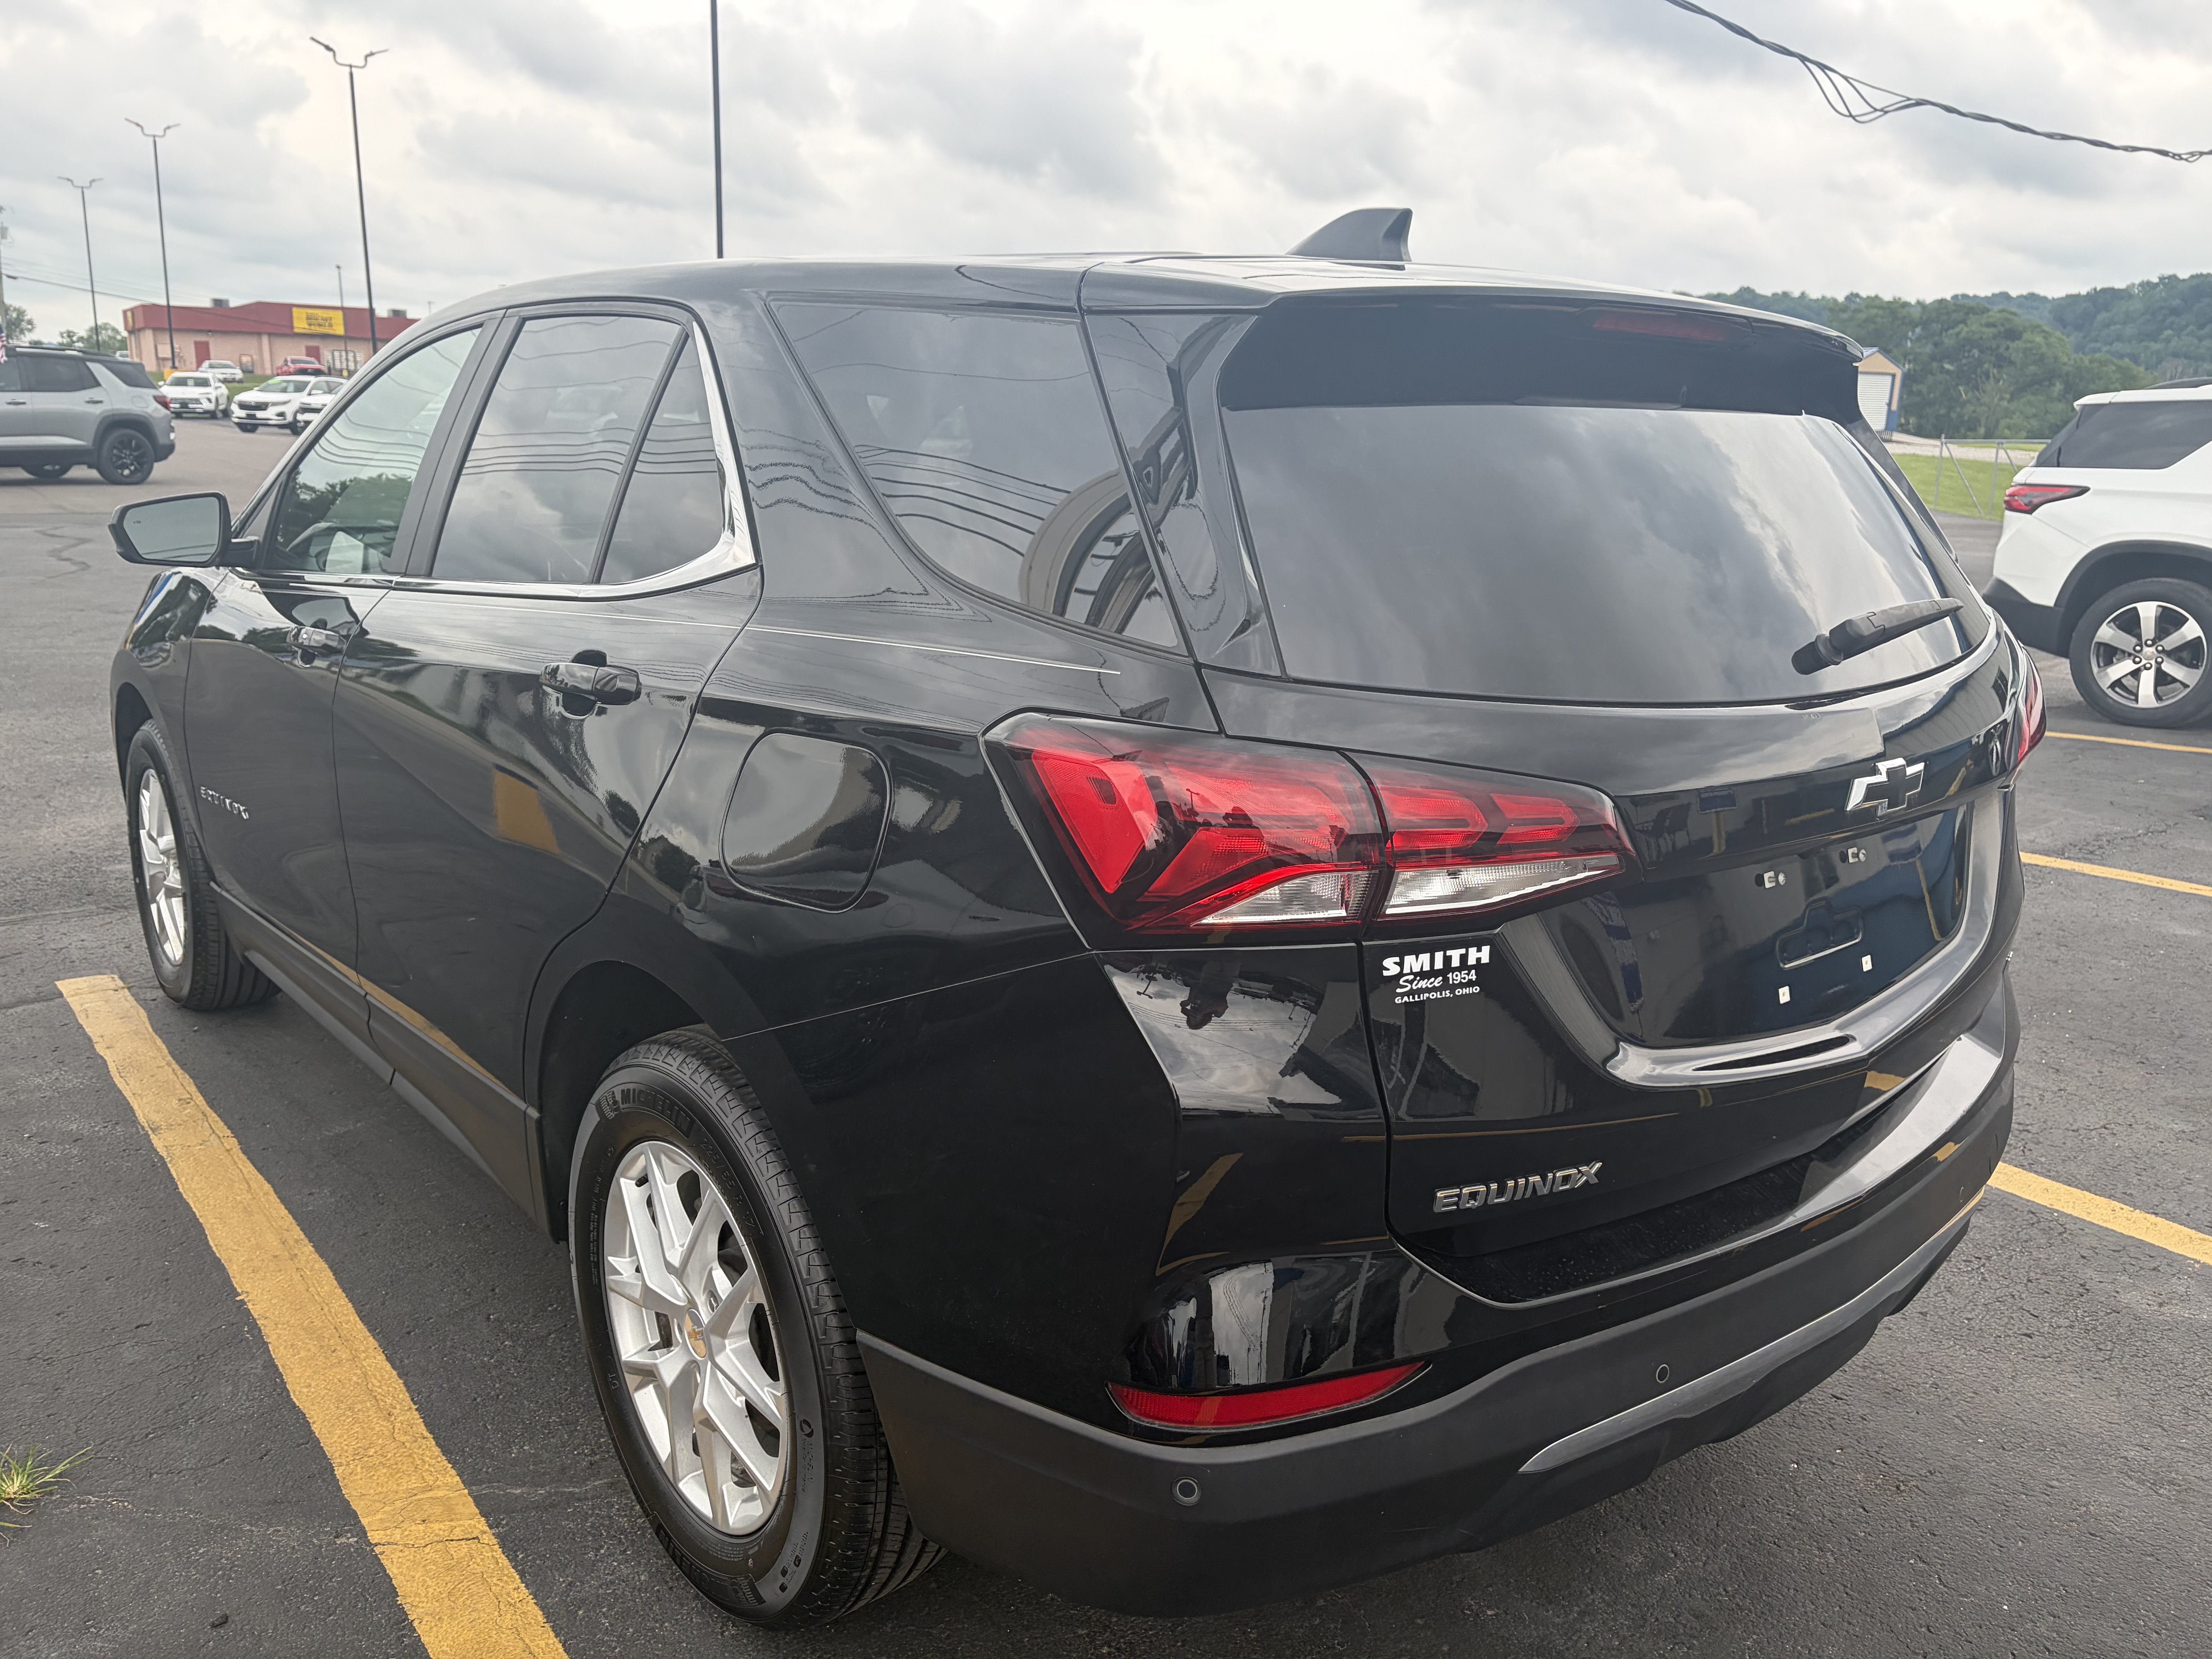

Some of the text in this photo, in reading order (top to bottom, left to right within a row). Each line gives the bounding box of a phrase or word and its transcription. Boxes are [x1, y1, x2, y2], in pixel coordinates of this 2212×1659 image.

[1382, 945, 1491, 976] SMITH
[1395, 986, 1480, 1004] GALLIPOLIS, OHIO
[1396, 969, 1477, 993] Since 1954
[620, 1088, 694, 1139] MICHELIN
[1433, 1159, 1603, 1213] EQUINOX
